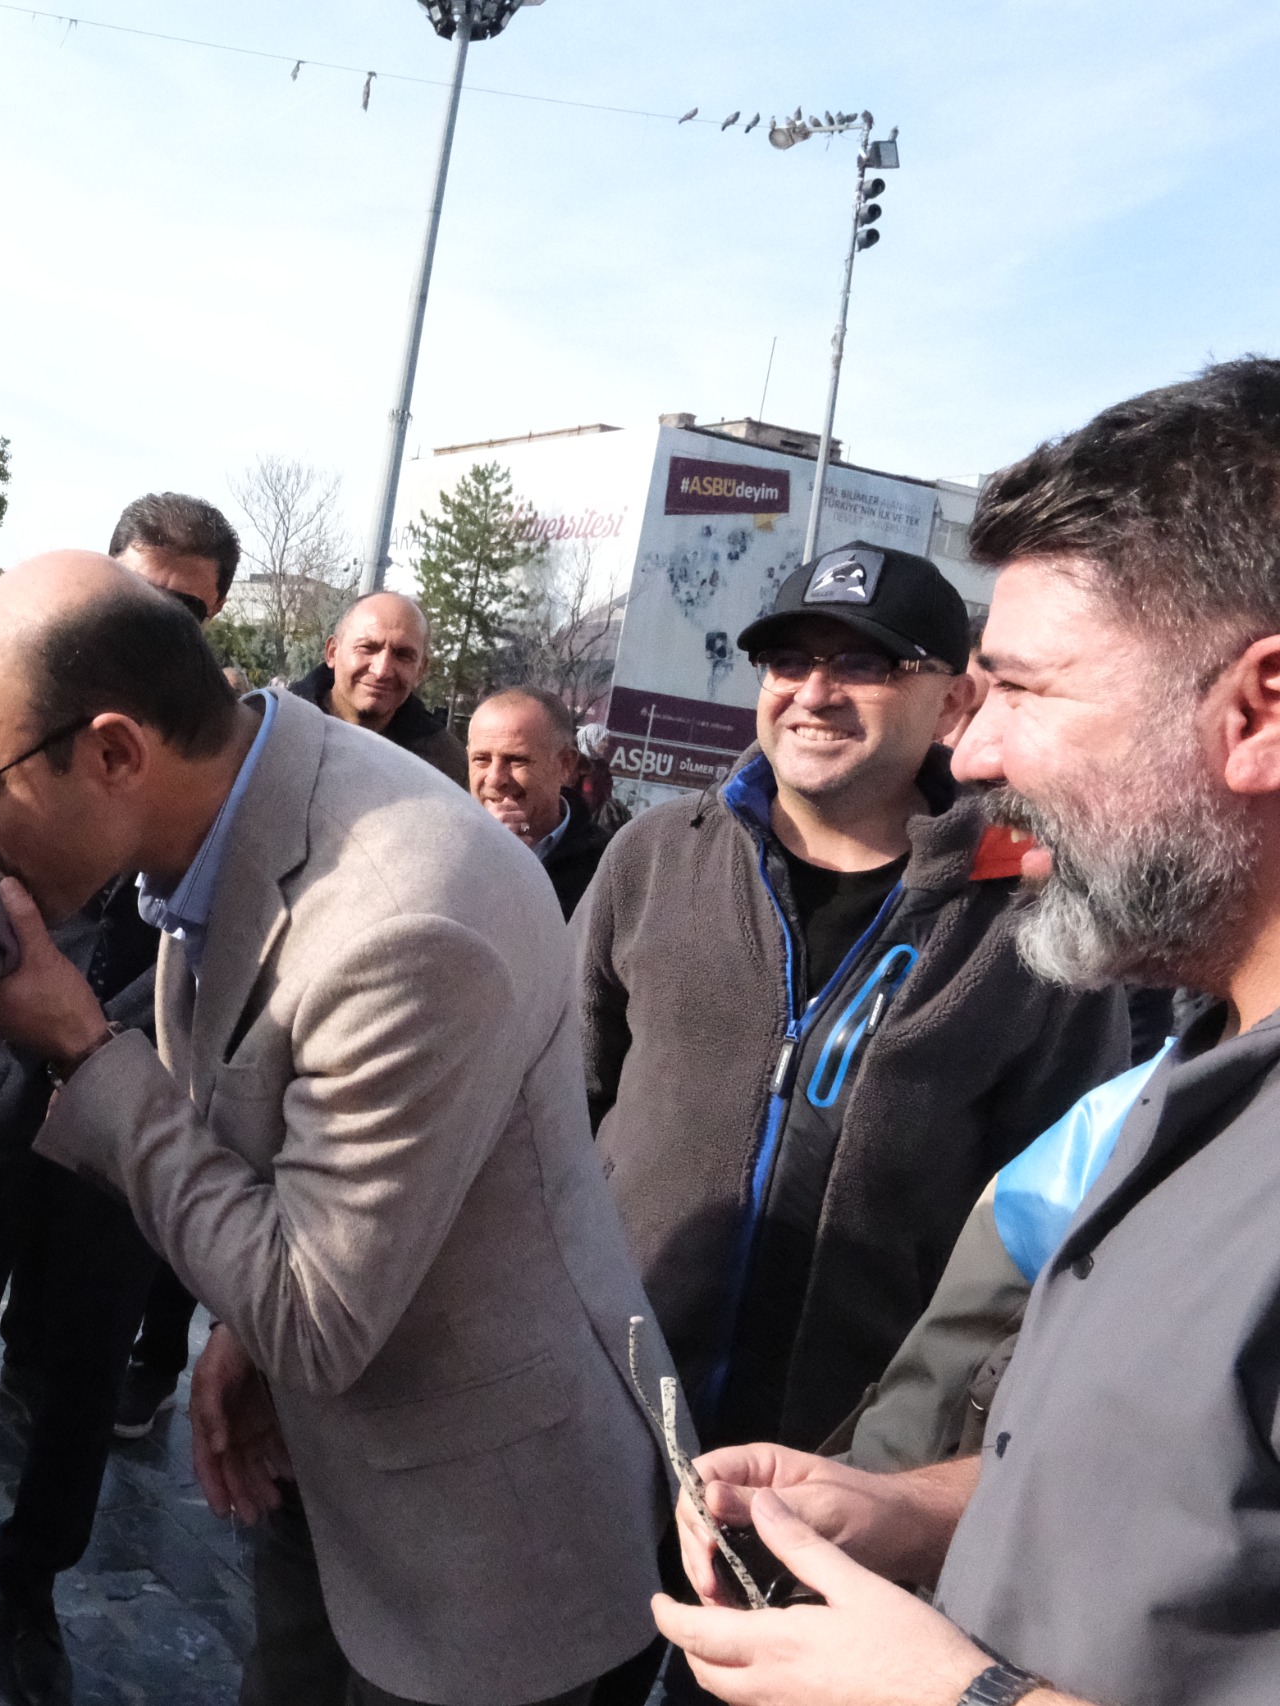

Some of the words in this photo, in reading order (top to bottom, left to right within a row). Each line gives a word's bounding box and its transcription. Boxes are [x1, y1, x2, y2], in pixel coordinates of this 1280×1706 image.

[680, 475, 779, 503] #ASBÜdeyim
[808, 481, 838, 497] SYAL
[609, 746, 674, 776] ASBÜ
